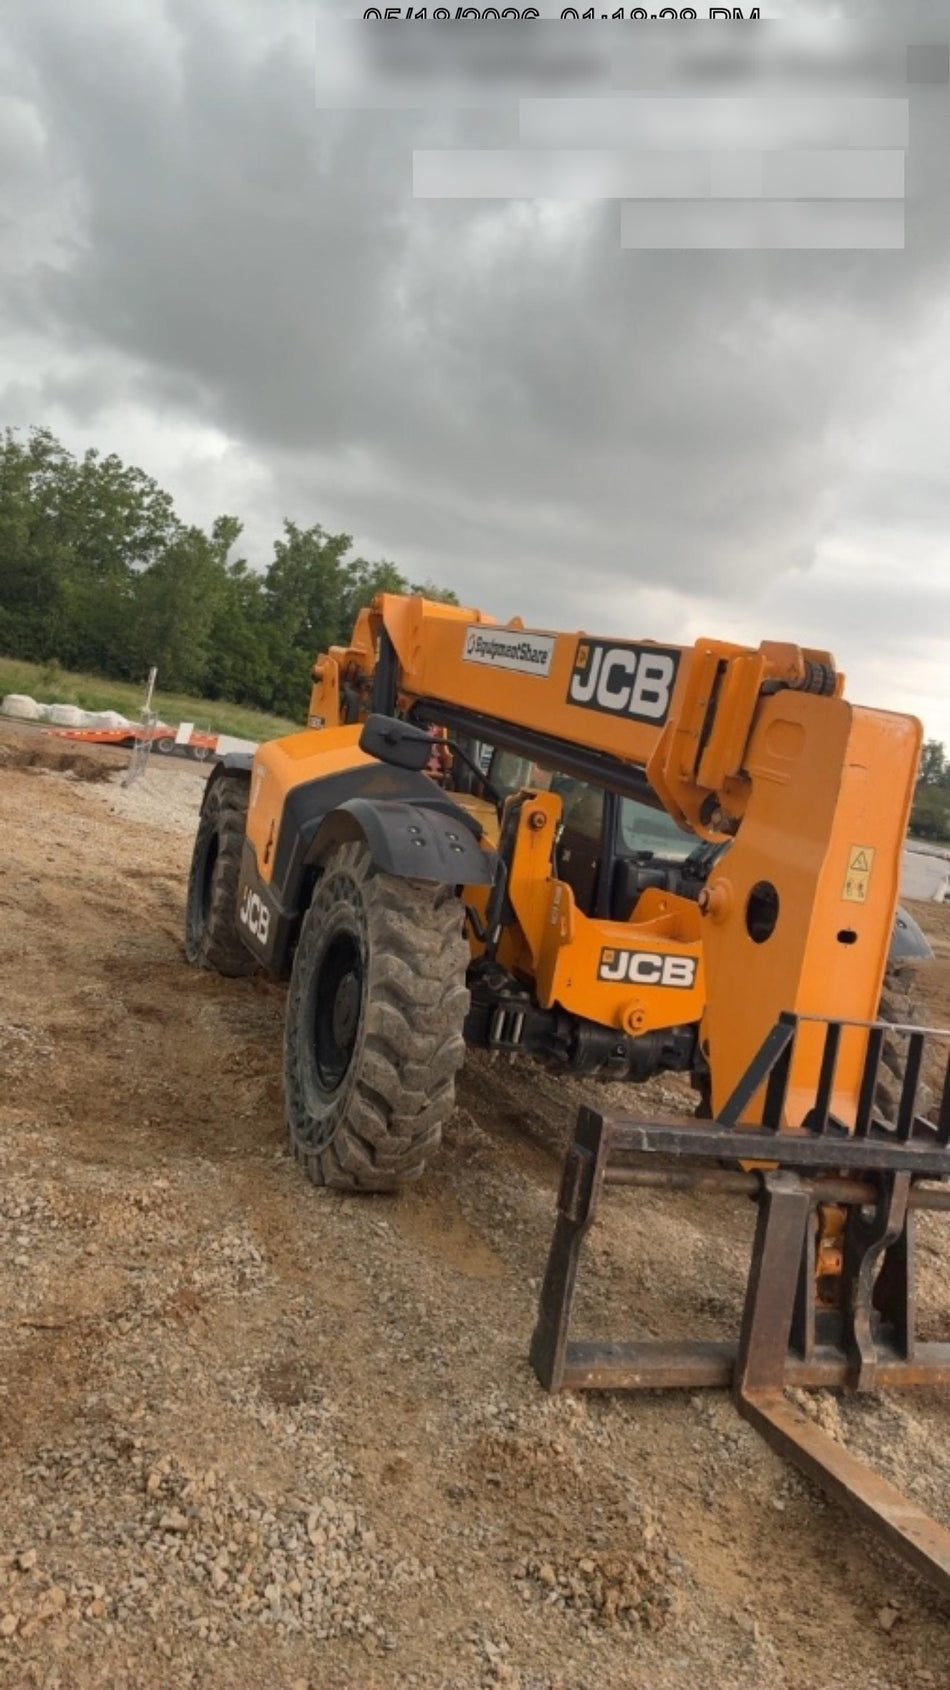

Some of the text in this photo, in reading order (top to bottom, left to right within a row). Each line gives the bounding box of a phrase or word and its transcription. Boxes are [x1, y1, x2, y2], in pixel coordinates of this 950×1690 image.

[570, 646, 675, 719] JCB
[240, 890, 271, 945] JCB
[600, 951, 695, 987] JCB
